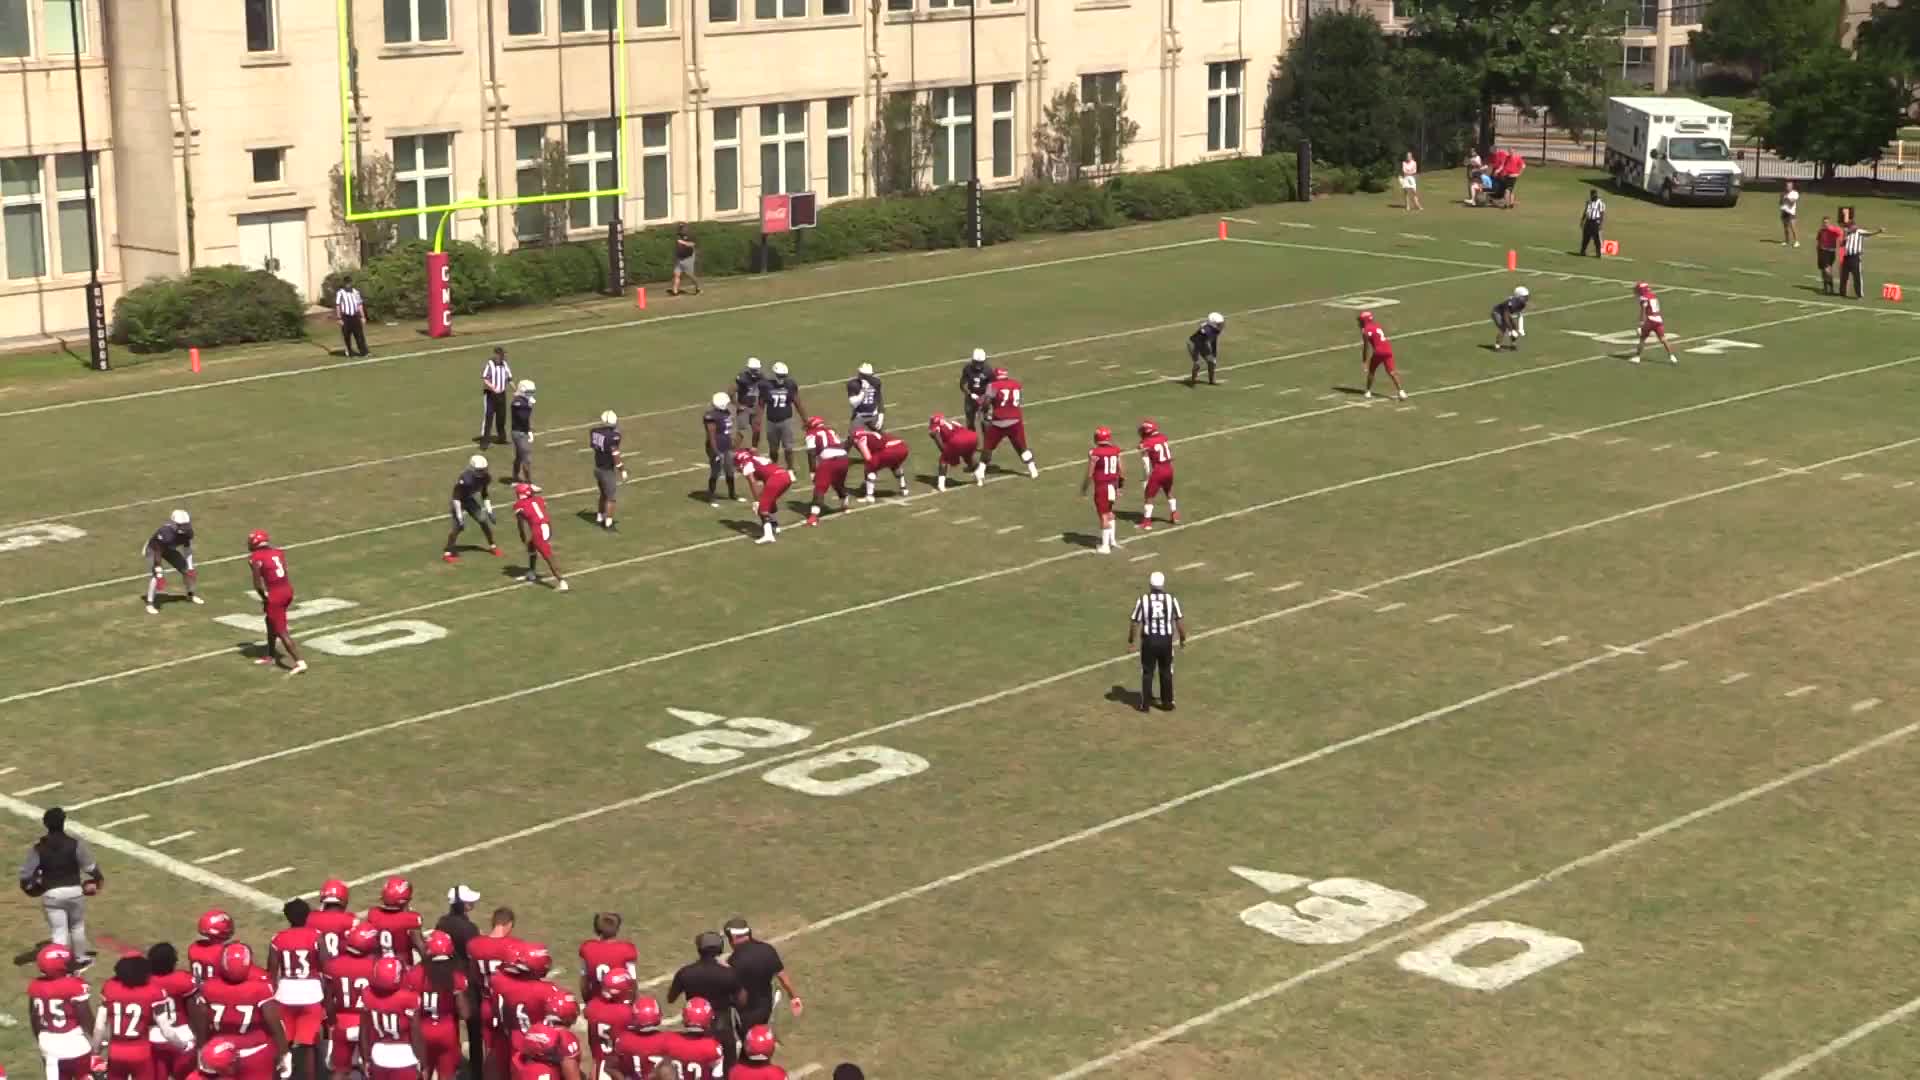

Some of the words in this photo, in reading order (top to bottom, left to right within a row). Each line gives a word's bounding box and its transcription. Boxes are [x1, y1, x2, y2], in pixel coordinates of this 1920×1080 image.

[1151, 601, 1165, 618] R
[283, 950, 310, 978] 13
[113, 1001, 142, 1037] 12
[210, 1003, 254, 1034] 77
[371, 1011, 401, 1041] 14
